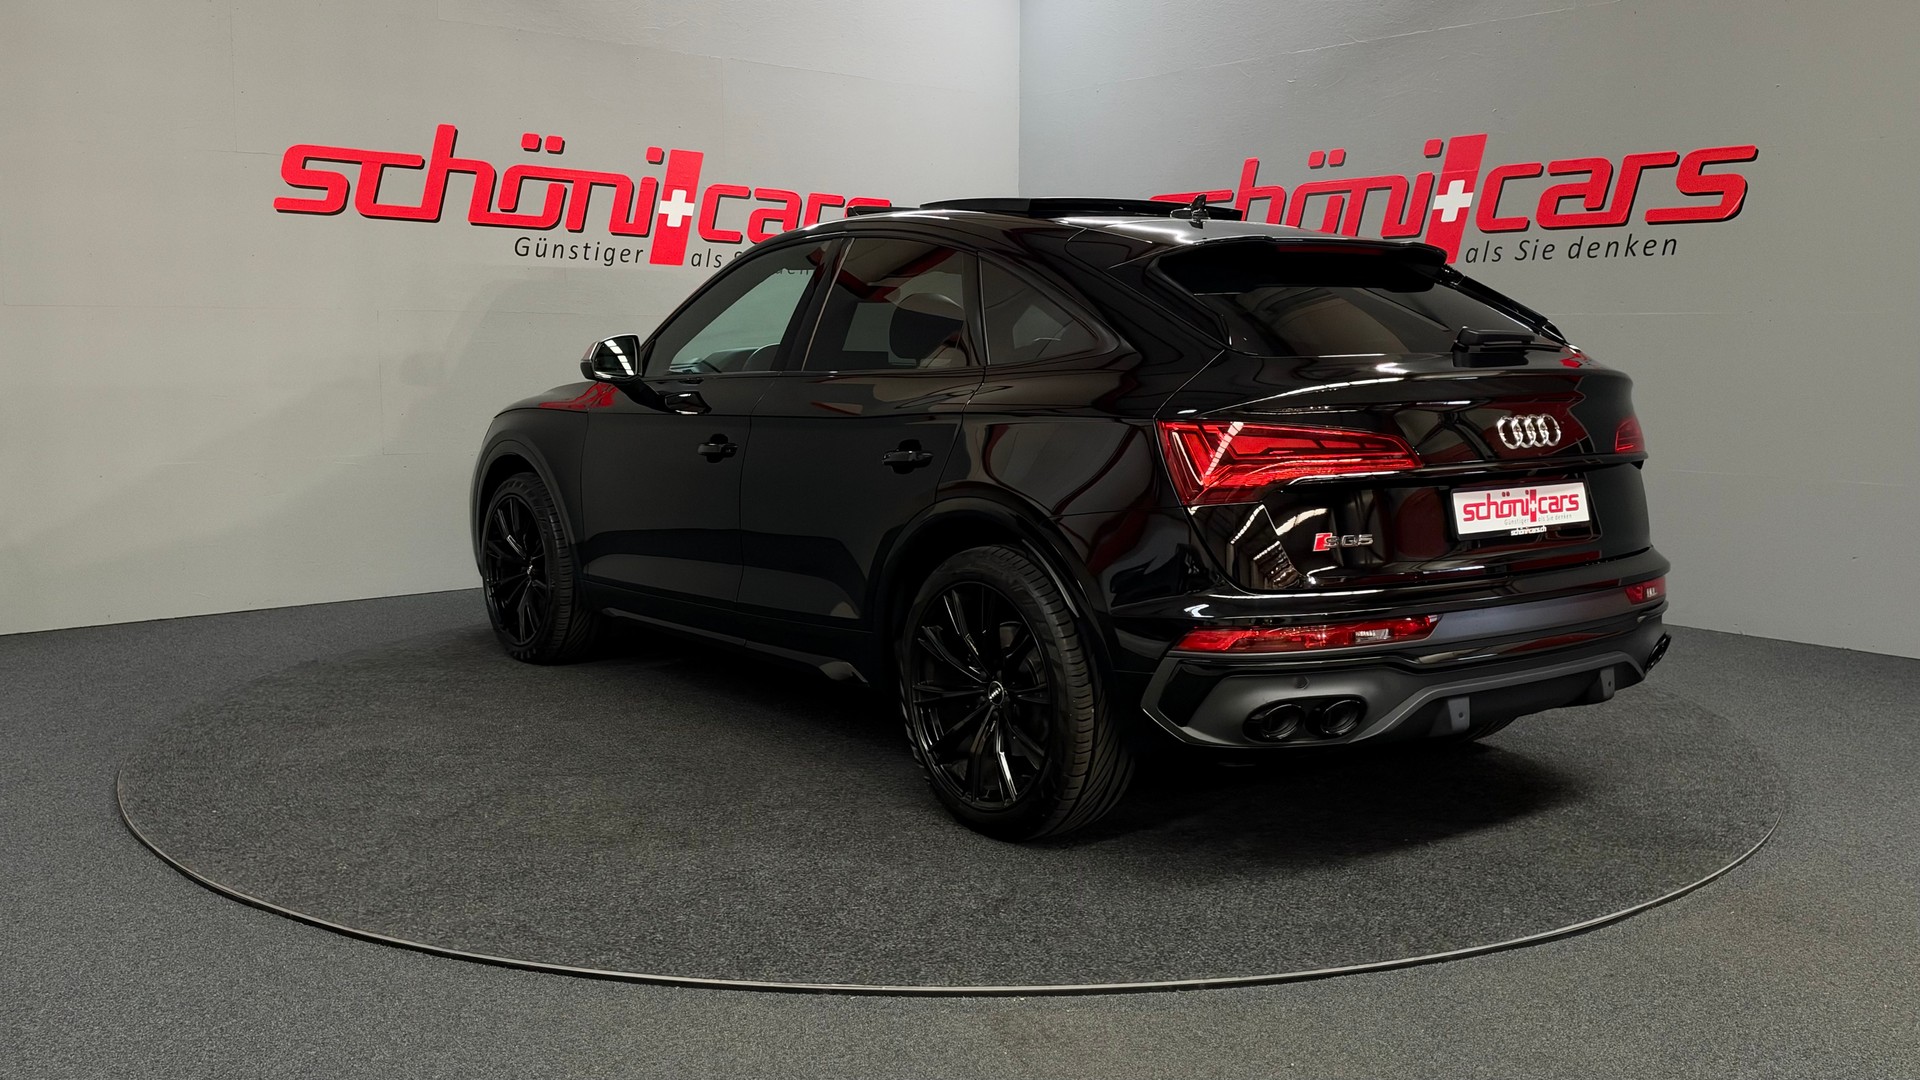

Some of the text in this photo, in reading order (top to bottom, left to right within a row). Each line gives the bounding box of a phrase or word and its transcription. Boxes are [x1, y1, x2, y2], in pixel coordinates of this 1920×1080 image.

[1149, 139, 1759, 239] höni cars
[514, 237, 644, 267] Günstiger
[690, 248, 723, 269] als
[1464, 233, 1678, 264] als Sie denken
